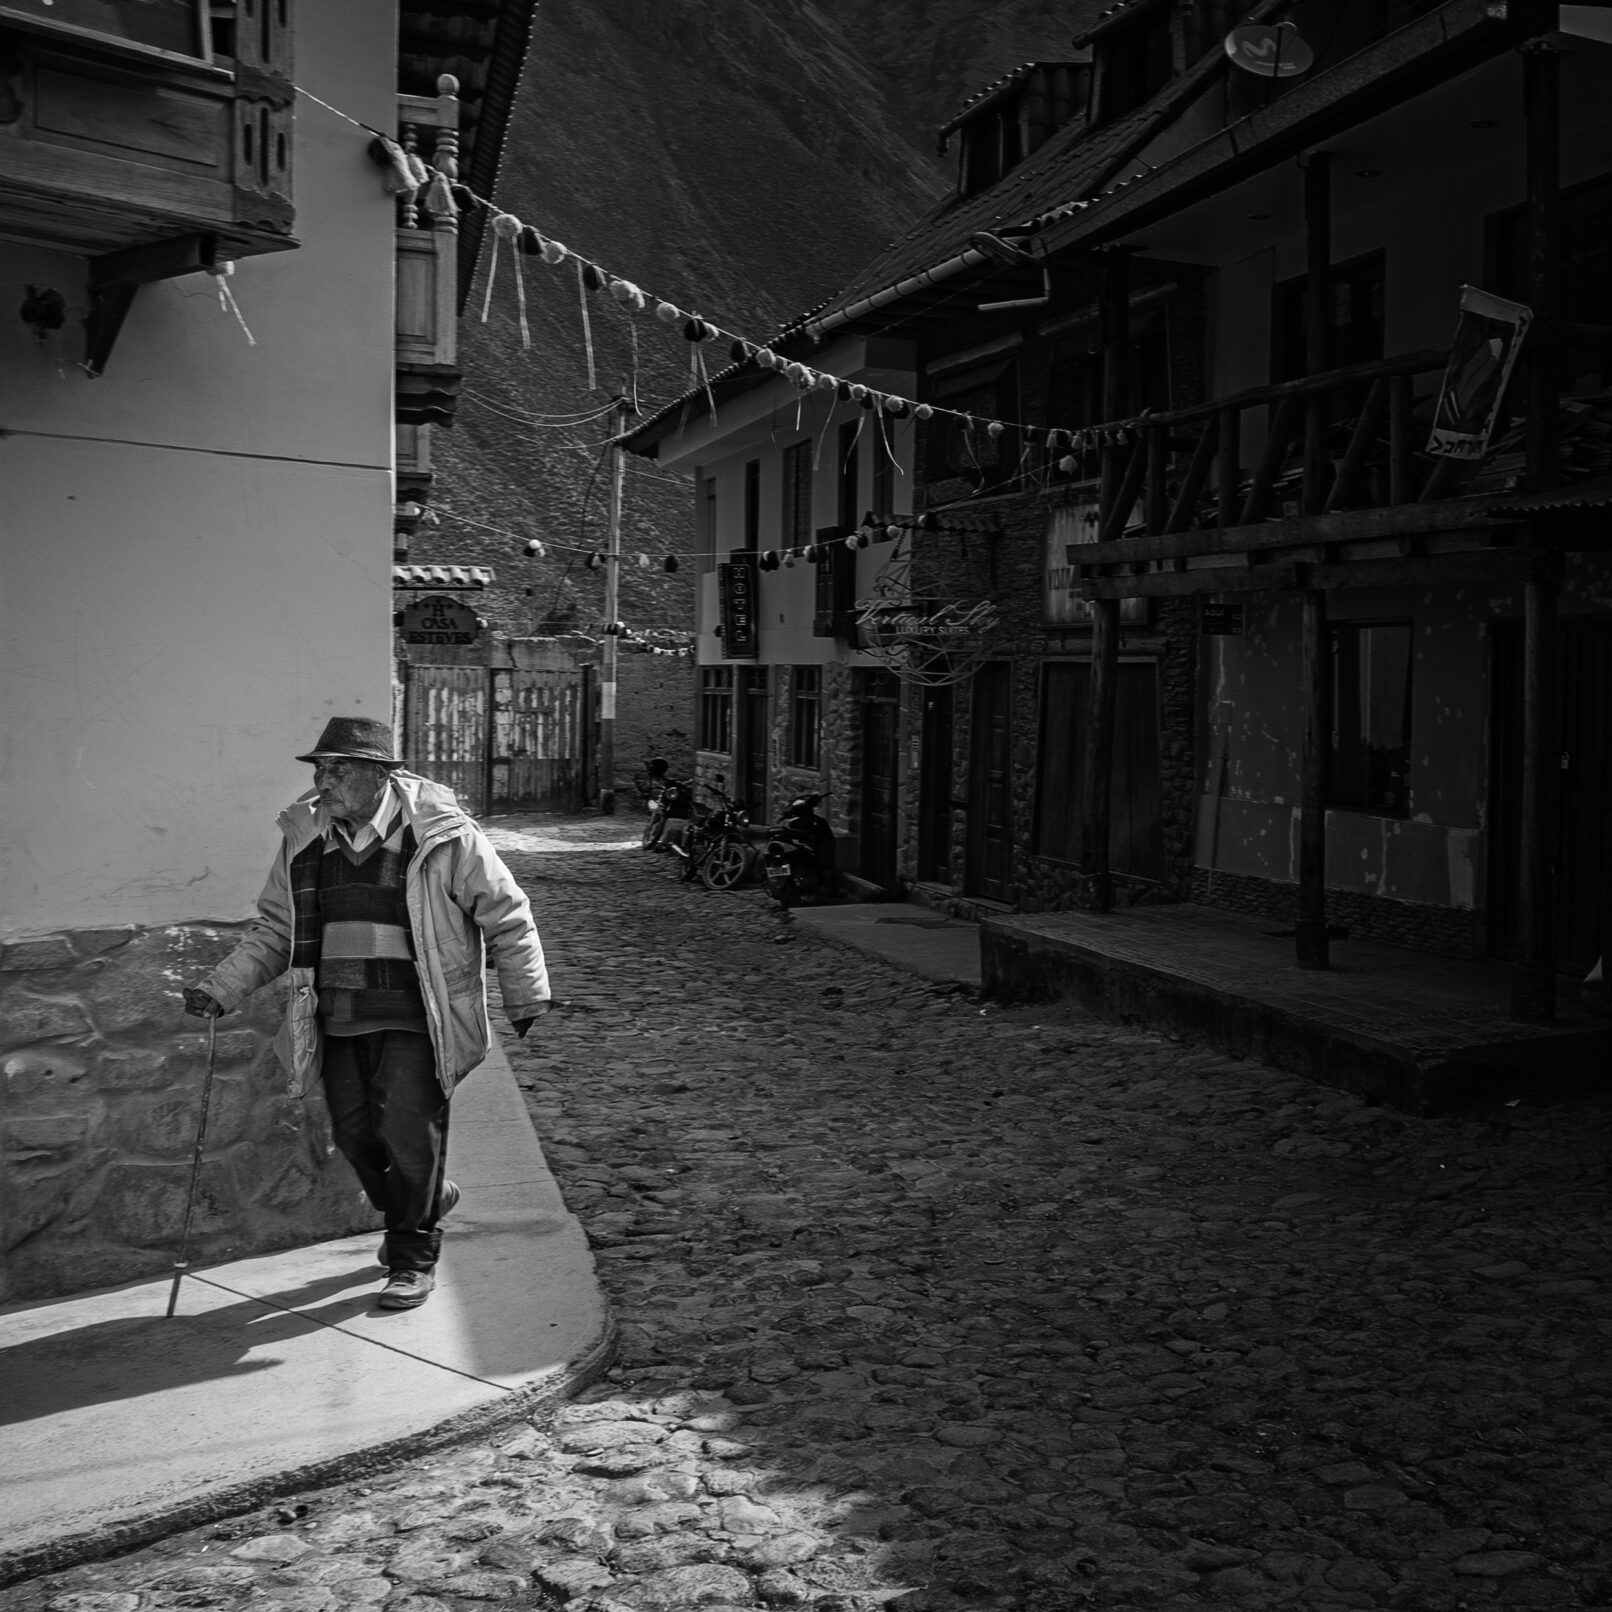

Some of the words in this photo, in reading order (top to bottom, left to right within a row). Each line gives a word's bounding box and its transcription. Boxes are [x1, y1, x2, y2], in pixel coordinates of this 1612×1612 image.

[732, 566, 747, 642] HOTEL
[945, 599, 1000, 634] Sky
[421, 617, 458, 630] CASA
[895, 625, 935, 635] LUXURY
[408, 631, 471, 644] ESTEVES
